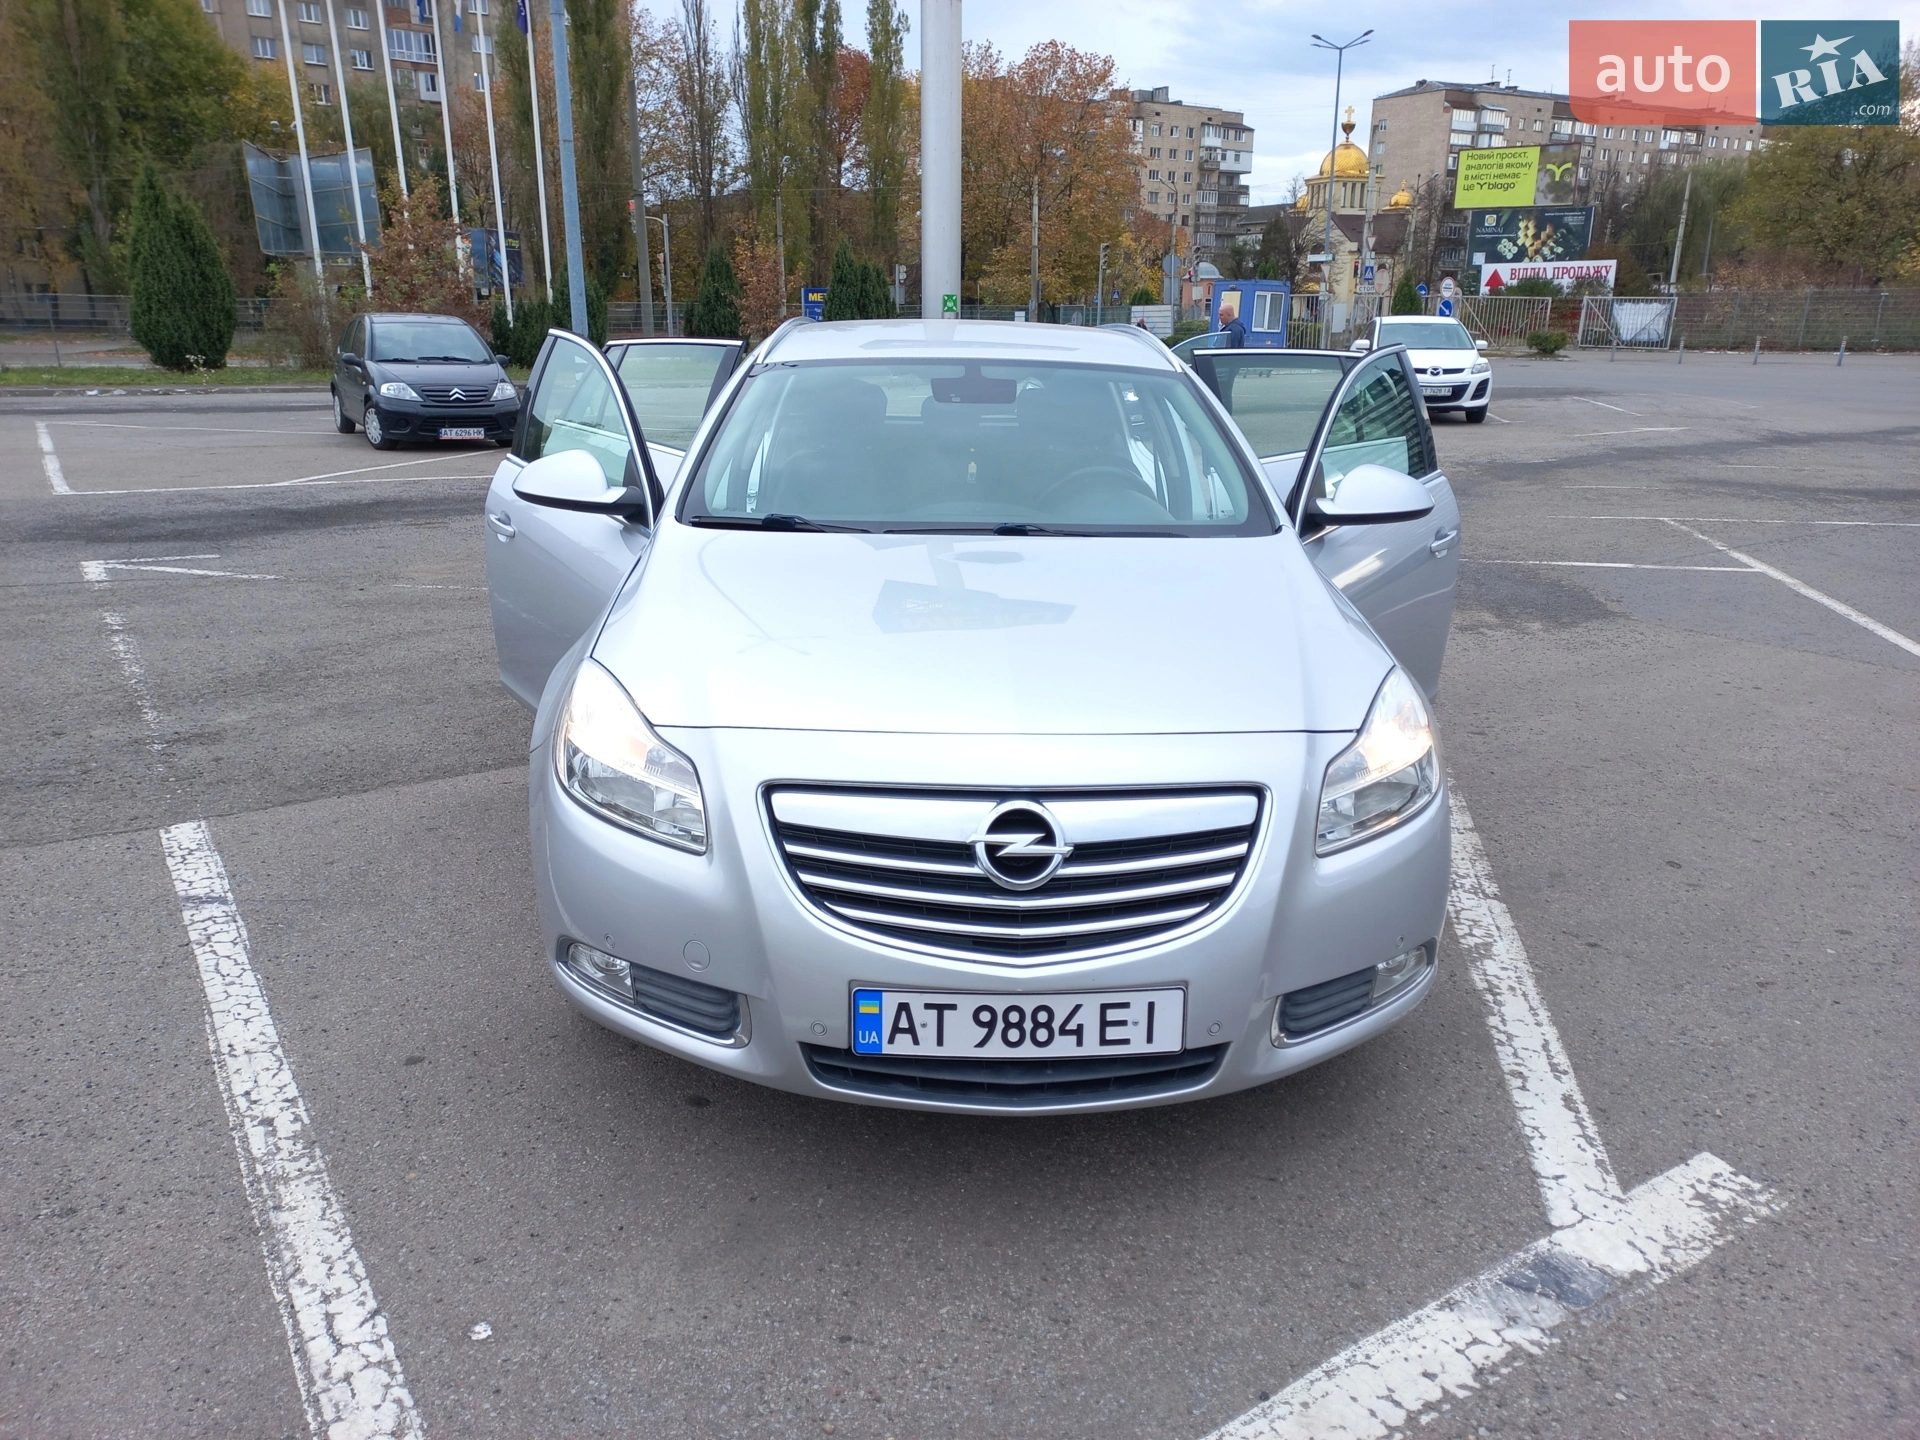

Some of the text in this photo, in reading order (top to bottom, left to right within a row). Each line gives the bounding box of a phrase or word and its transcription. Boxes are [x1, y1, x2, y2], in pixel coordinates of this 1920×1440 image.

[1466, 151, 1528, 161] Новий проєкт,
[1465, 162, 1533, 171] аналогів якому
[1471, 172, 1491, 180] місті
[1463, 183, 1475, 191] це
[1552, 265, 1612, 280] ПРОДАЖУ
[443, 429, 453, 437] AT
[455, 429, 471, 437] 6296
[887, 1001, 1155, 1049] AT 9884 EI
[859, 1031, 879, 1044] UA
